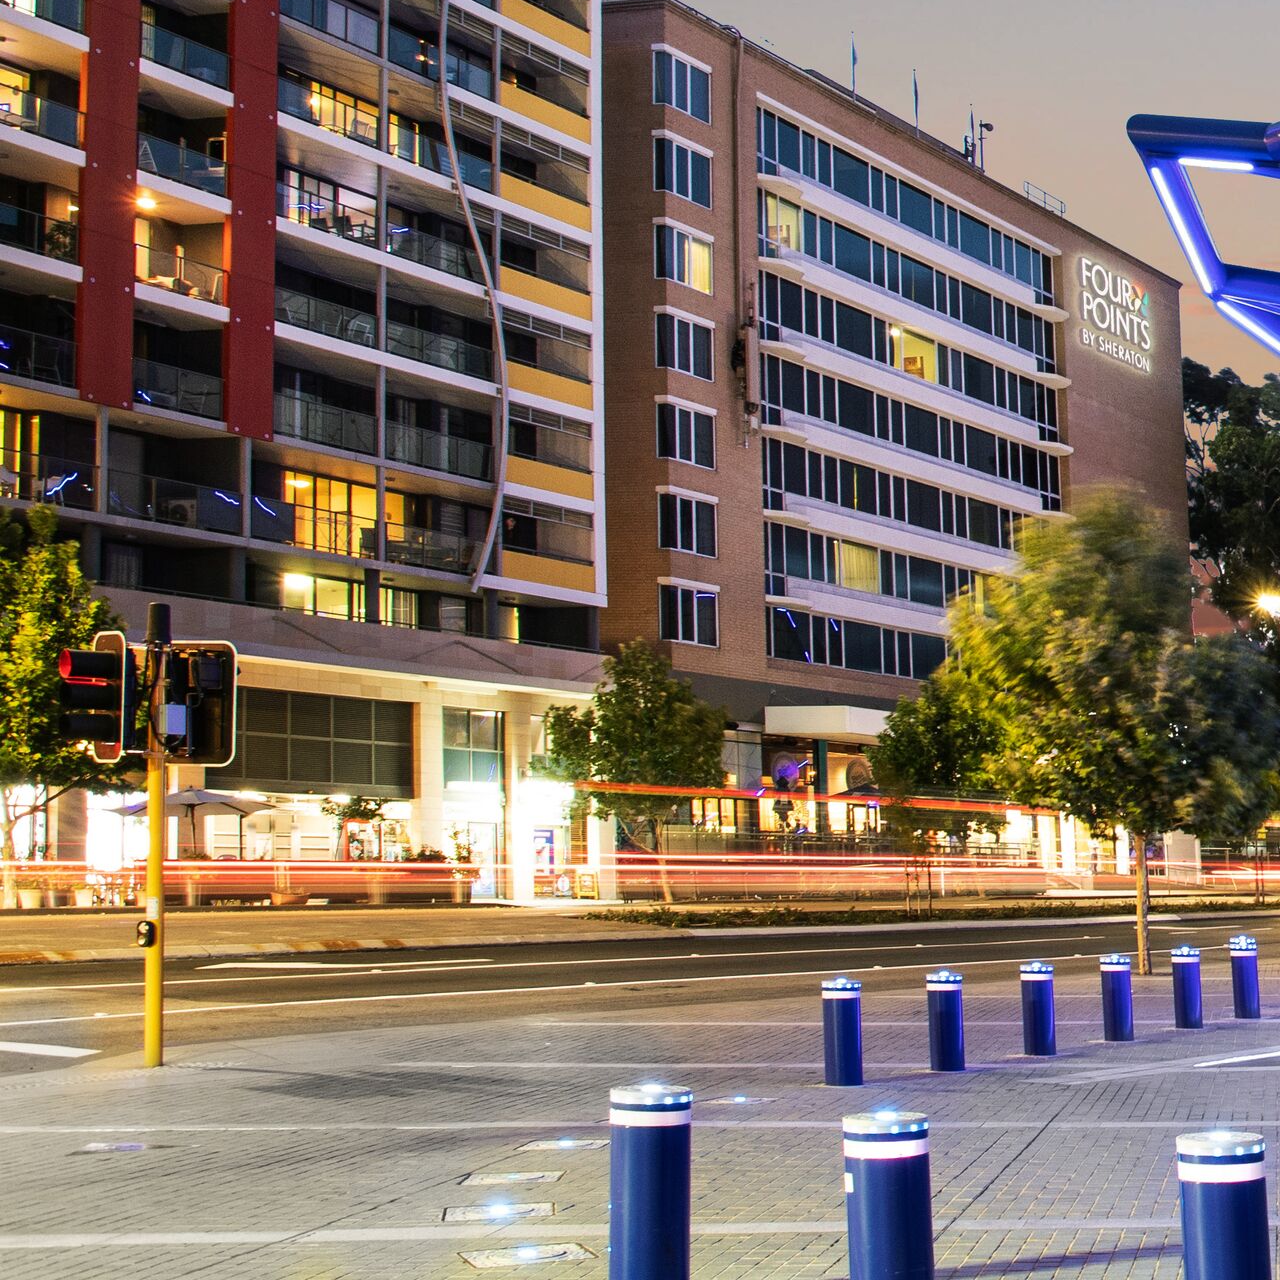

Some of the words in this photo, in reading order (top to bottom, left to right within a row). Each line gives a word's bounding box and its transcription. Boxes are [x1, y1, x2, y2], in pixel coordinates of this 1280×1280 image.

[1081, 257, 1134, 311] FOUR
[1083, 291, 1150, 350] POINTS
[1083, 328, 1095, 346] BY
[1099, 337, 1150, 372] SHERATON
